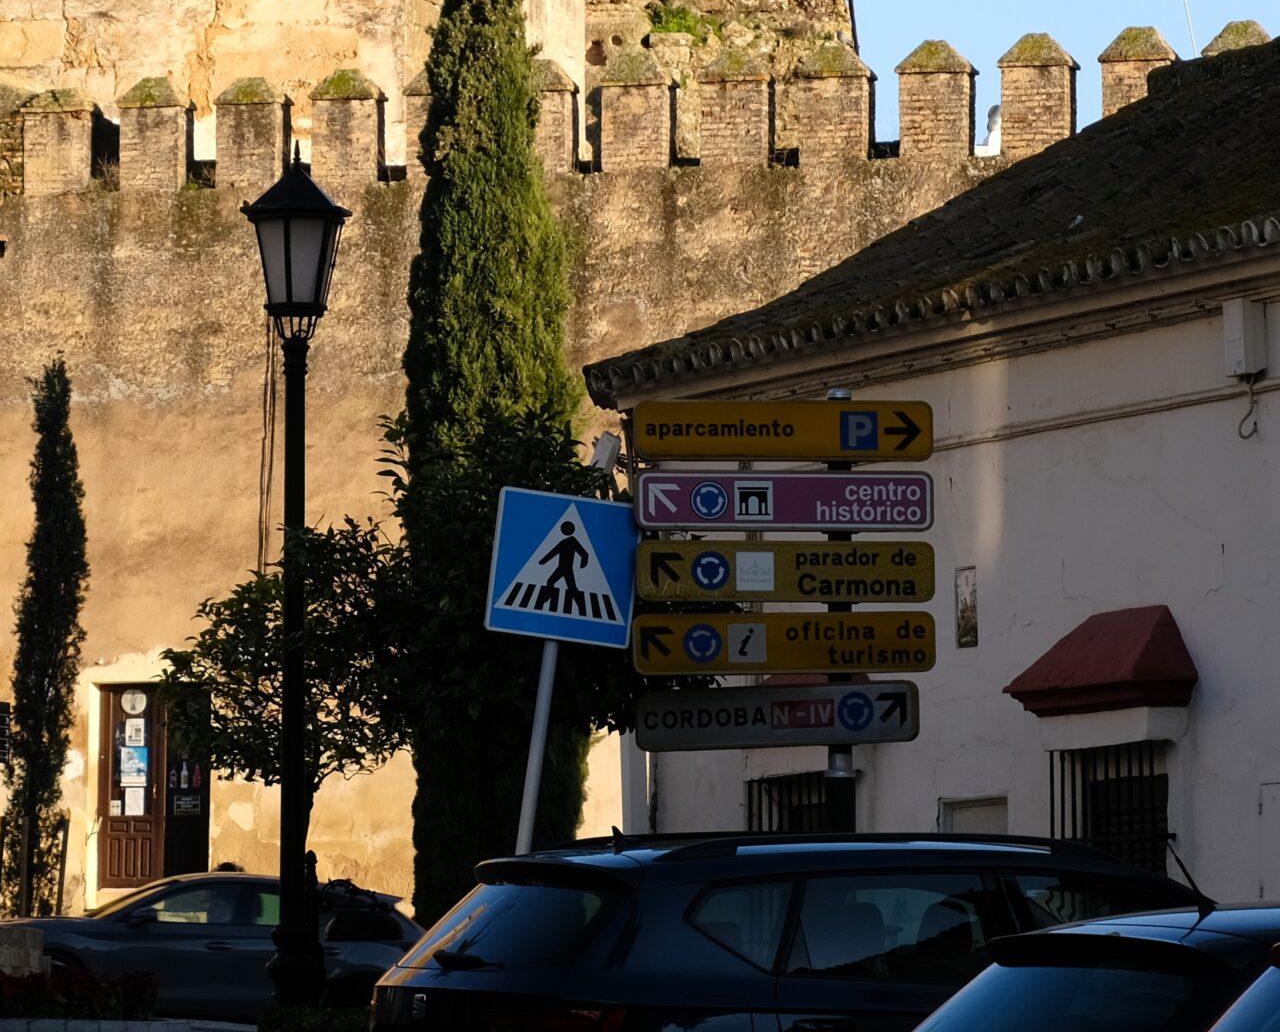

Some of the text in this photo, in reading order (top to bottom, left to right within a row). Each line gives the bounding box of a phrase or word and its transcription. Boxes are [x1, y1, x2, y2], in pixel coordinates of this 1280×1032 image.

[645, 414, 873, 447] aparcamiento P
[845, 482, 921, 501] centro
[816, 501, 921, 522] histórico
[795, 548, 917, 570] parador de
[797, 573, 916, 596] Carmona
[785, 620, 926, 641] oficina de
[828, 645, 926, 665] turismo
[643, 706, 767, 730] CORDOBA
